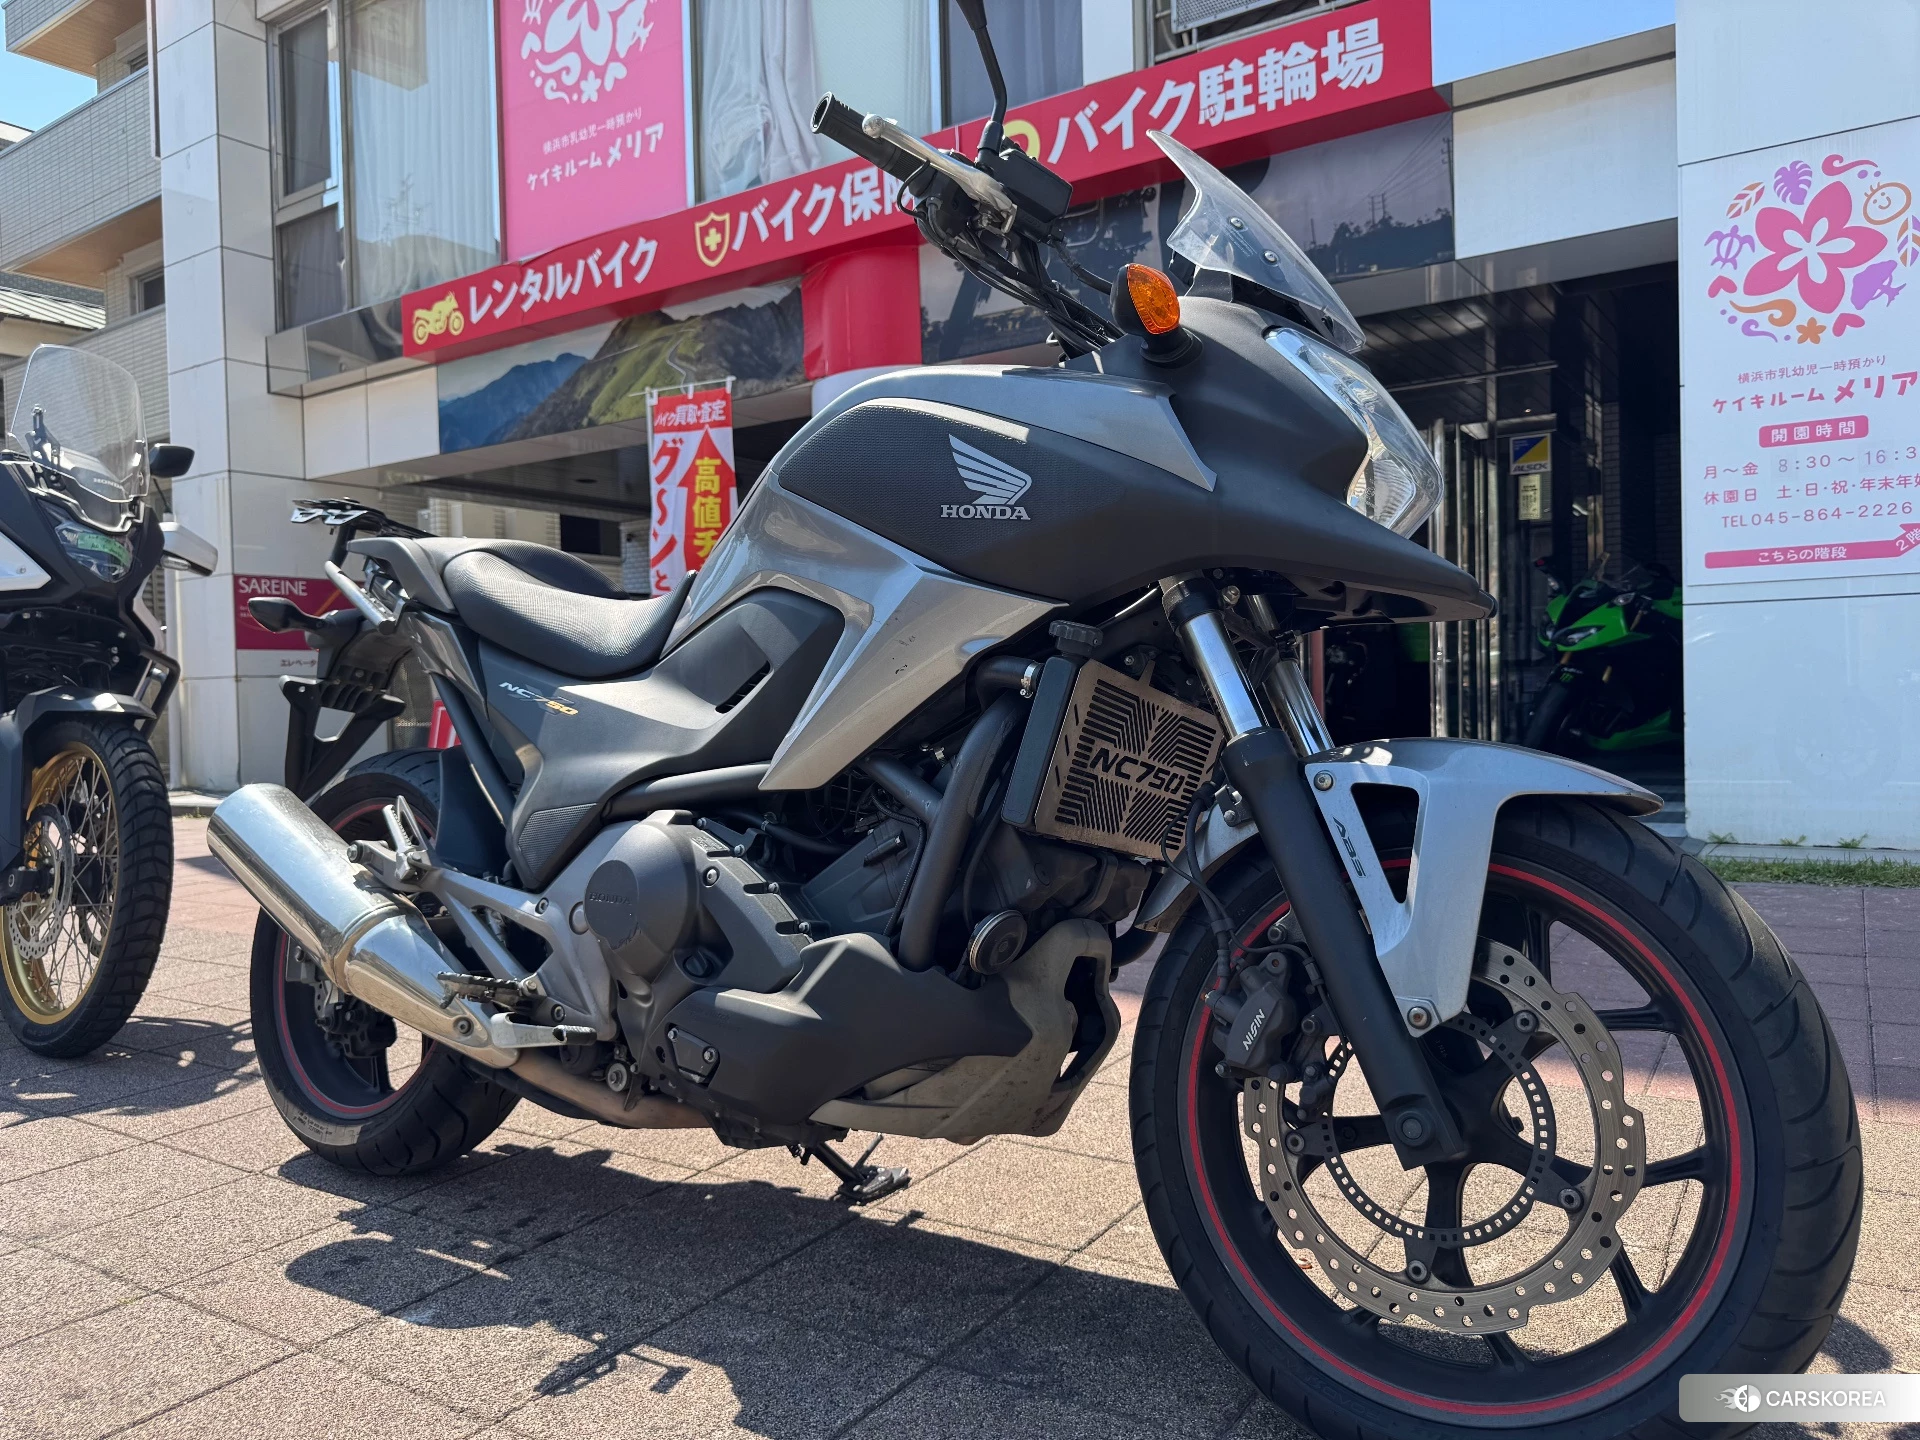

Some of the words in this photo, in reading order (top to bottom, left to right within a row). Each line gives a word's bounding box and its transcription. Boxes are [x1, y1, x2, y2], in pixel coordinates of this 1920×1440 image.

[1048, 18, 1384, 165] バイク駐輪場
[527, 151, 602, 190] ケイキルーム
[606, 122, 664, 168] メリア
[469, 236, 658, 324] レンタルバイク
[1738, 354, 1886, 384] 横浜市乳幼児一時預かり
[1712, 387, 1825, 413] ケイキルーム
[1834, 371, 1918, 404] メリア
[1771, 420, 1856, 443] 開園時間
[692, 457, 723, 567] 高値チ
[940, 504, 1031, 520] HONDA
[1704, 488, 1757, 505] 休園日
[1758, 546, 1848, 564] こちらの階段
[239, 578, 308, 596] SAREINE
[499, 682, 579, 715] NC750
[1089, 747, 1185, 794] NC750
[1332, 816, 1367, 877] ABS
[589, 892, 632, 906] HONDA
